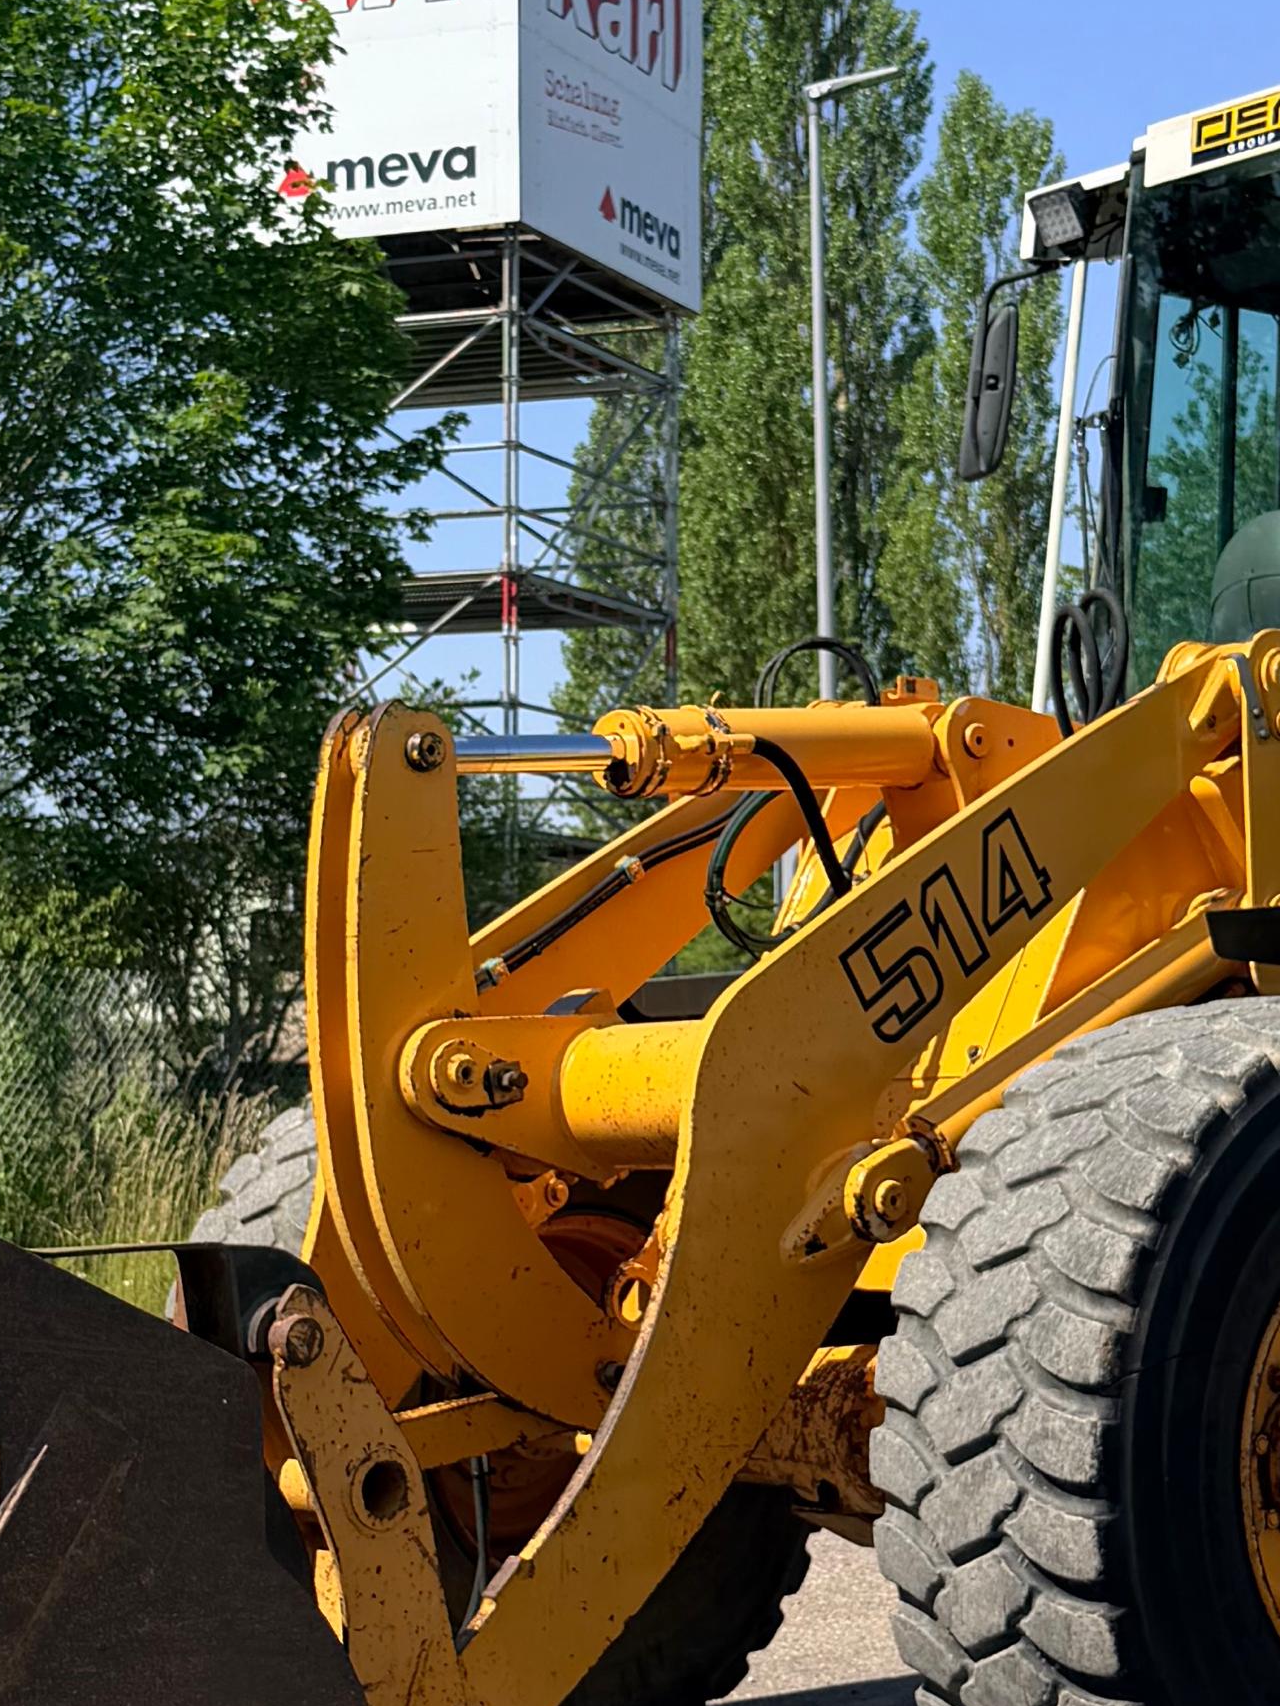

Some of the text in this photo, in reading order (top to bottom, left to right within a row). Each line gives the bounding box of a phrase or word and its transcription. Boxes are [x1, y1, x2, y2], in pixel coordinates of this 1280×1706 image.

[326, 145, 477, 191] meva
[1226, 132, 1276, 154] GROUP
[621, 196, 680, 260] meva
[838, 807, 1053, 1044] 514
